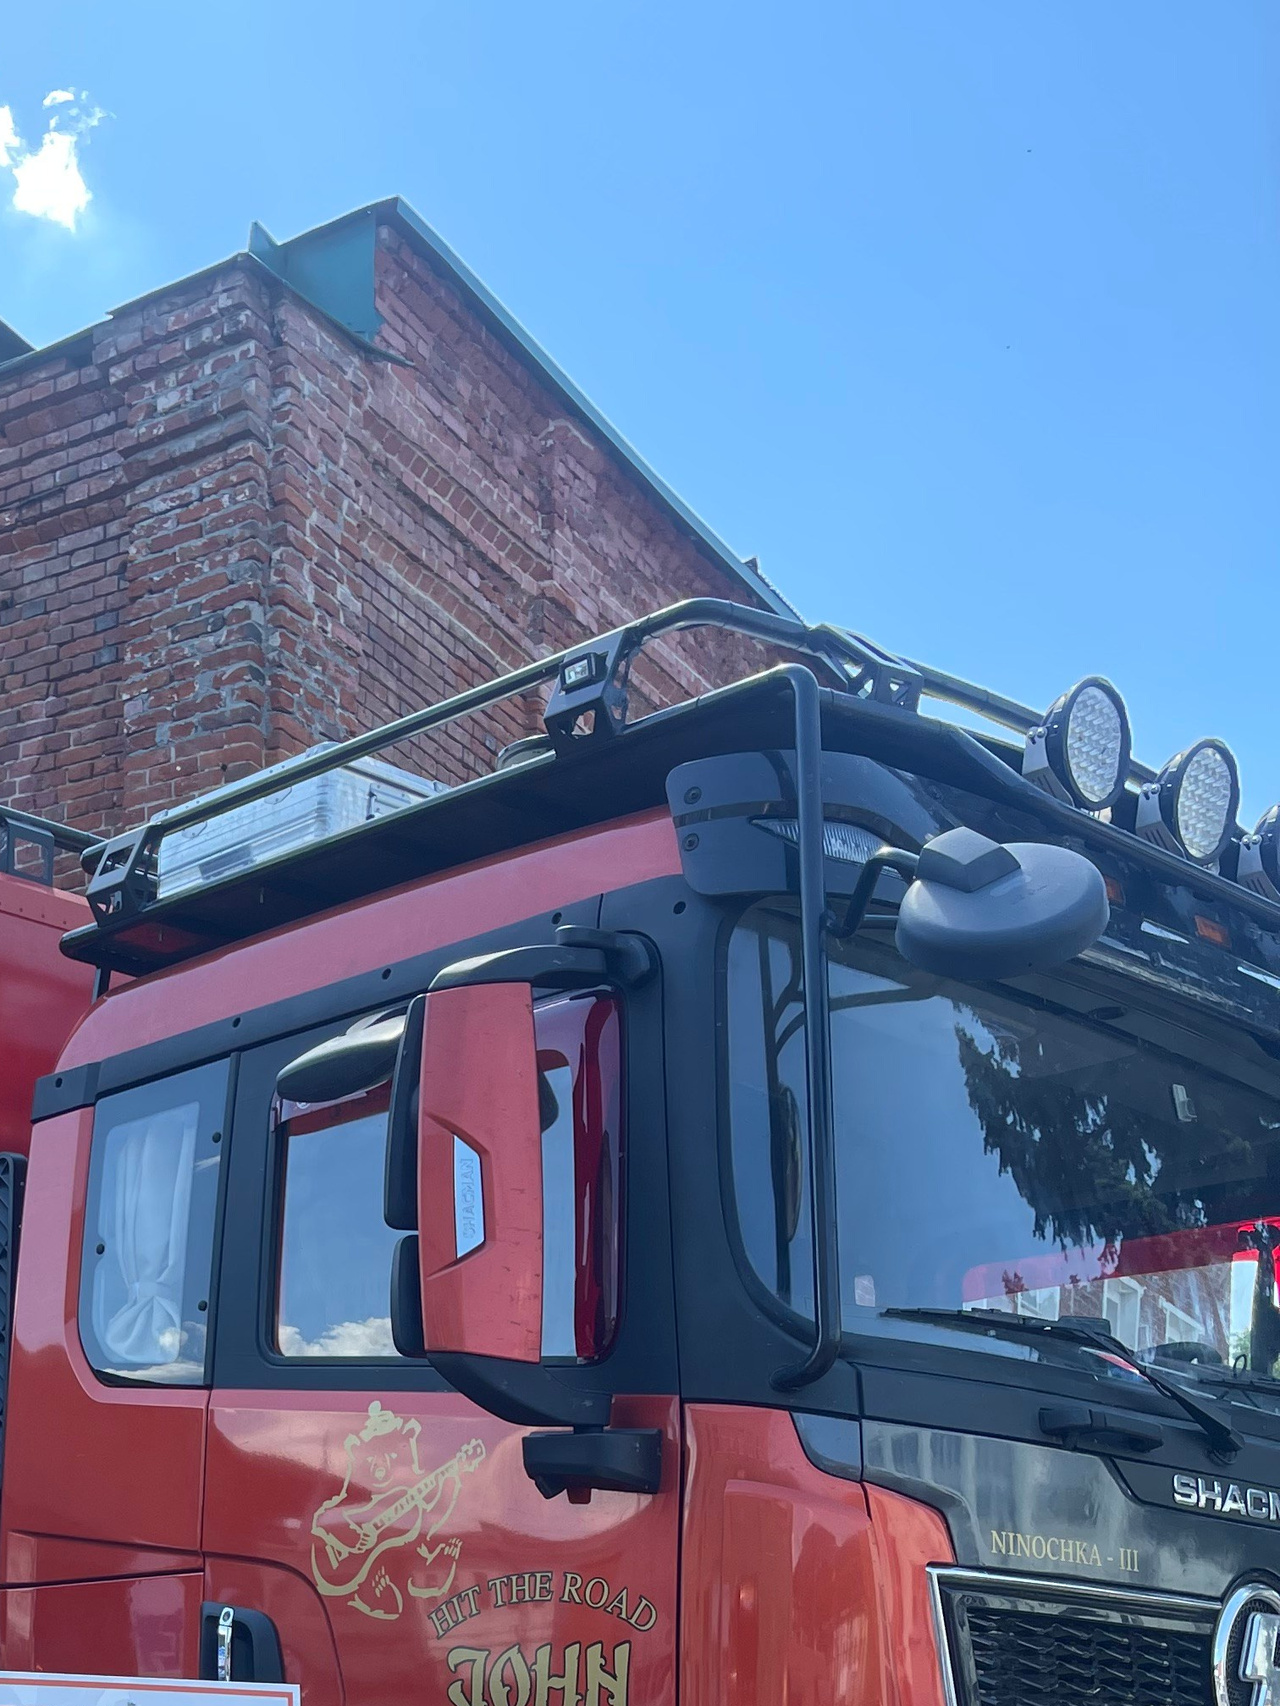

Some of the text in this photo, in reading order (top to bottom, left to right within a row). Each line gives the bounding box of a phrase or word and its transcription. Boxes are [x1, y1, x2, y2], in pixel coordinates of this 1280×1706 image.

[990, 1530, 1103, 1567] NINOCHKA
[1118, 1547, 1140, 1573] III
[427, 1570, 659, 1640] HIT THE ROAD
